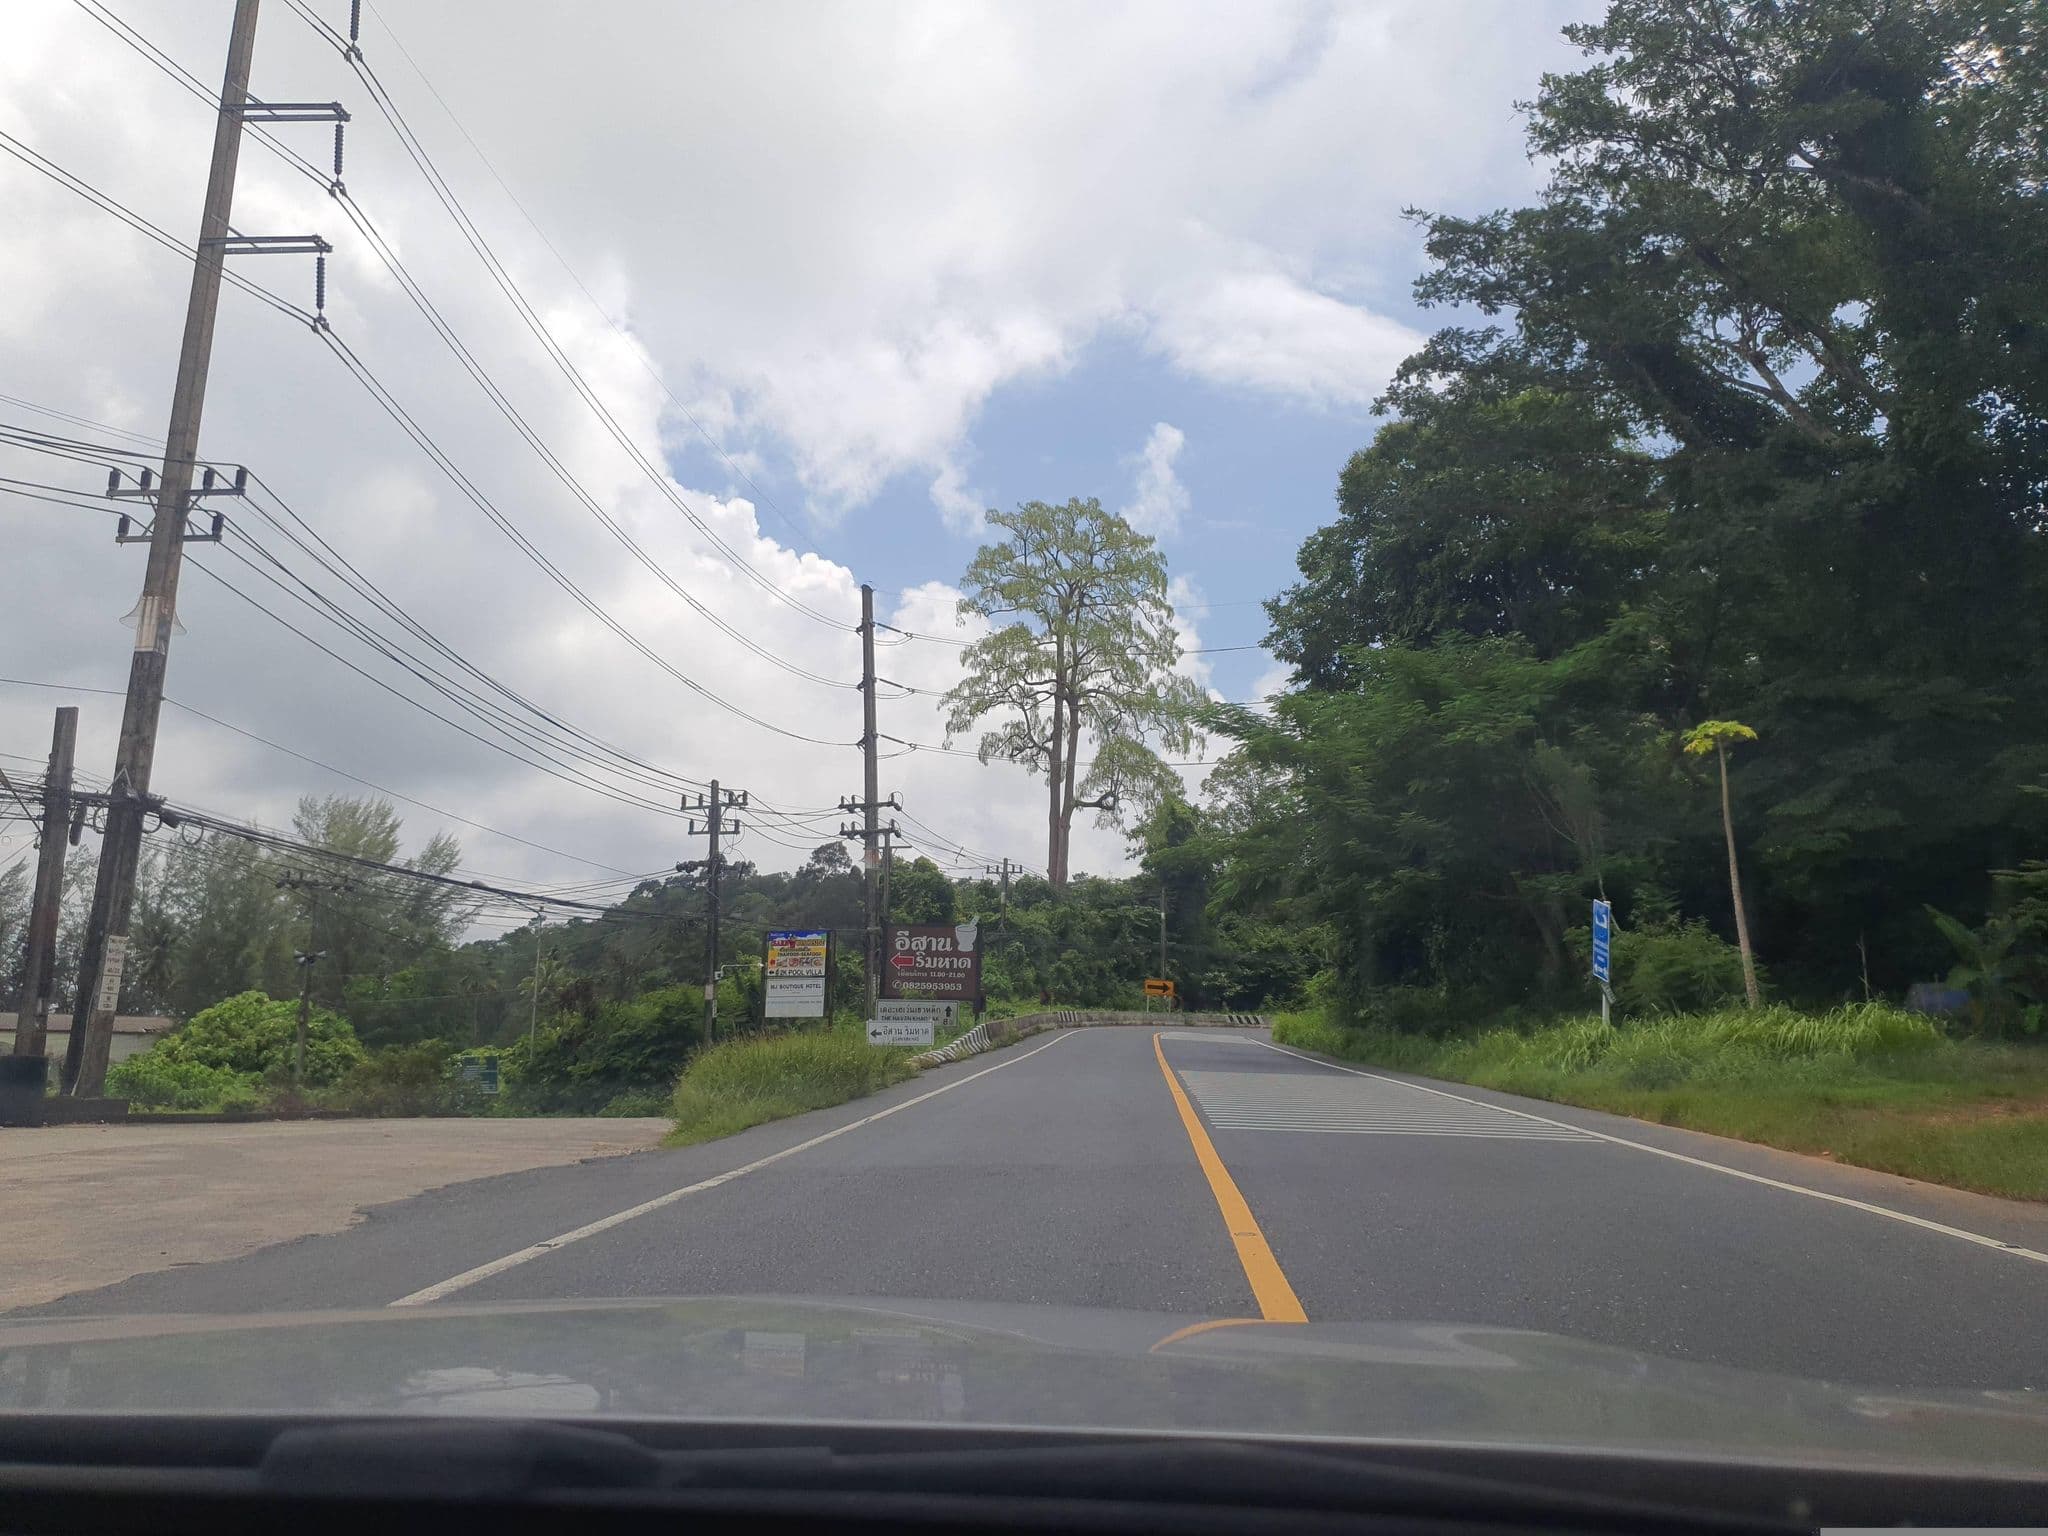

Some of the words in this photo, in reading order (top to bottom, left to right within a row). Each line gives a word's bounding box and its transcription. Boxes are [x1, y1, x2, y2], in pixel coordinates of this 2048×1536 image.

[894, 930, 953, 951] อีสาน
[915, 952, 971, 969] ริมหาด
